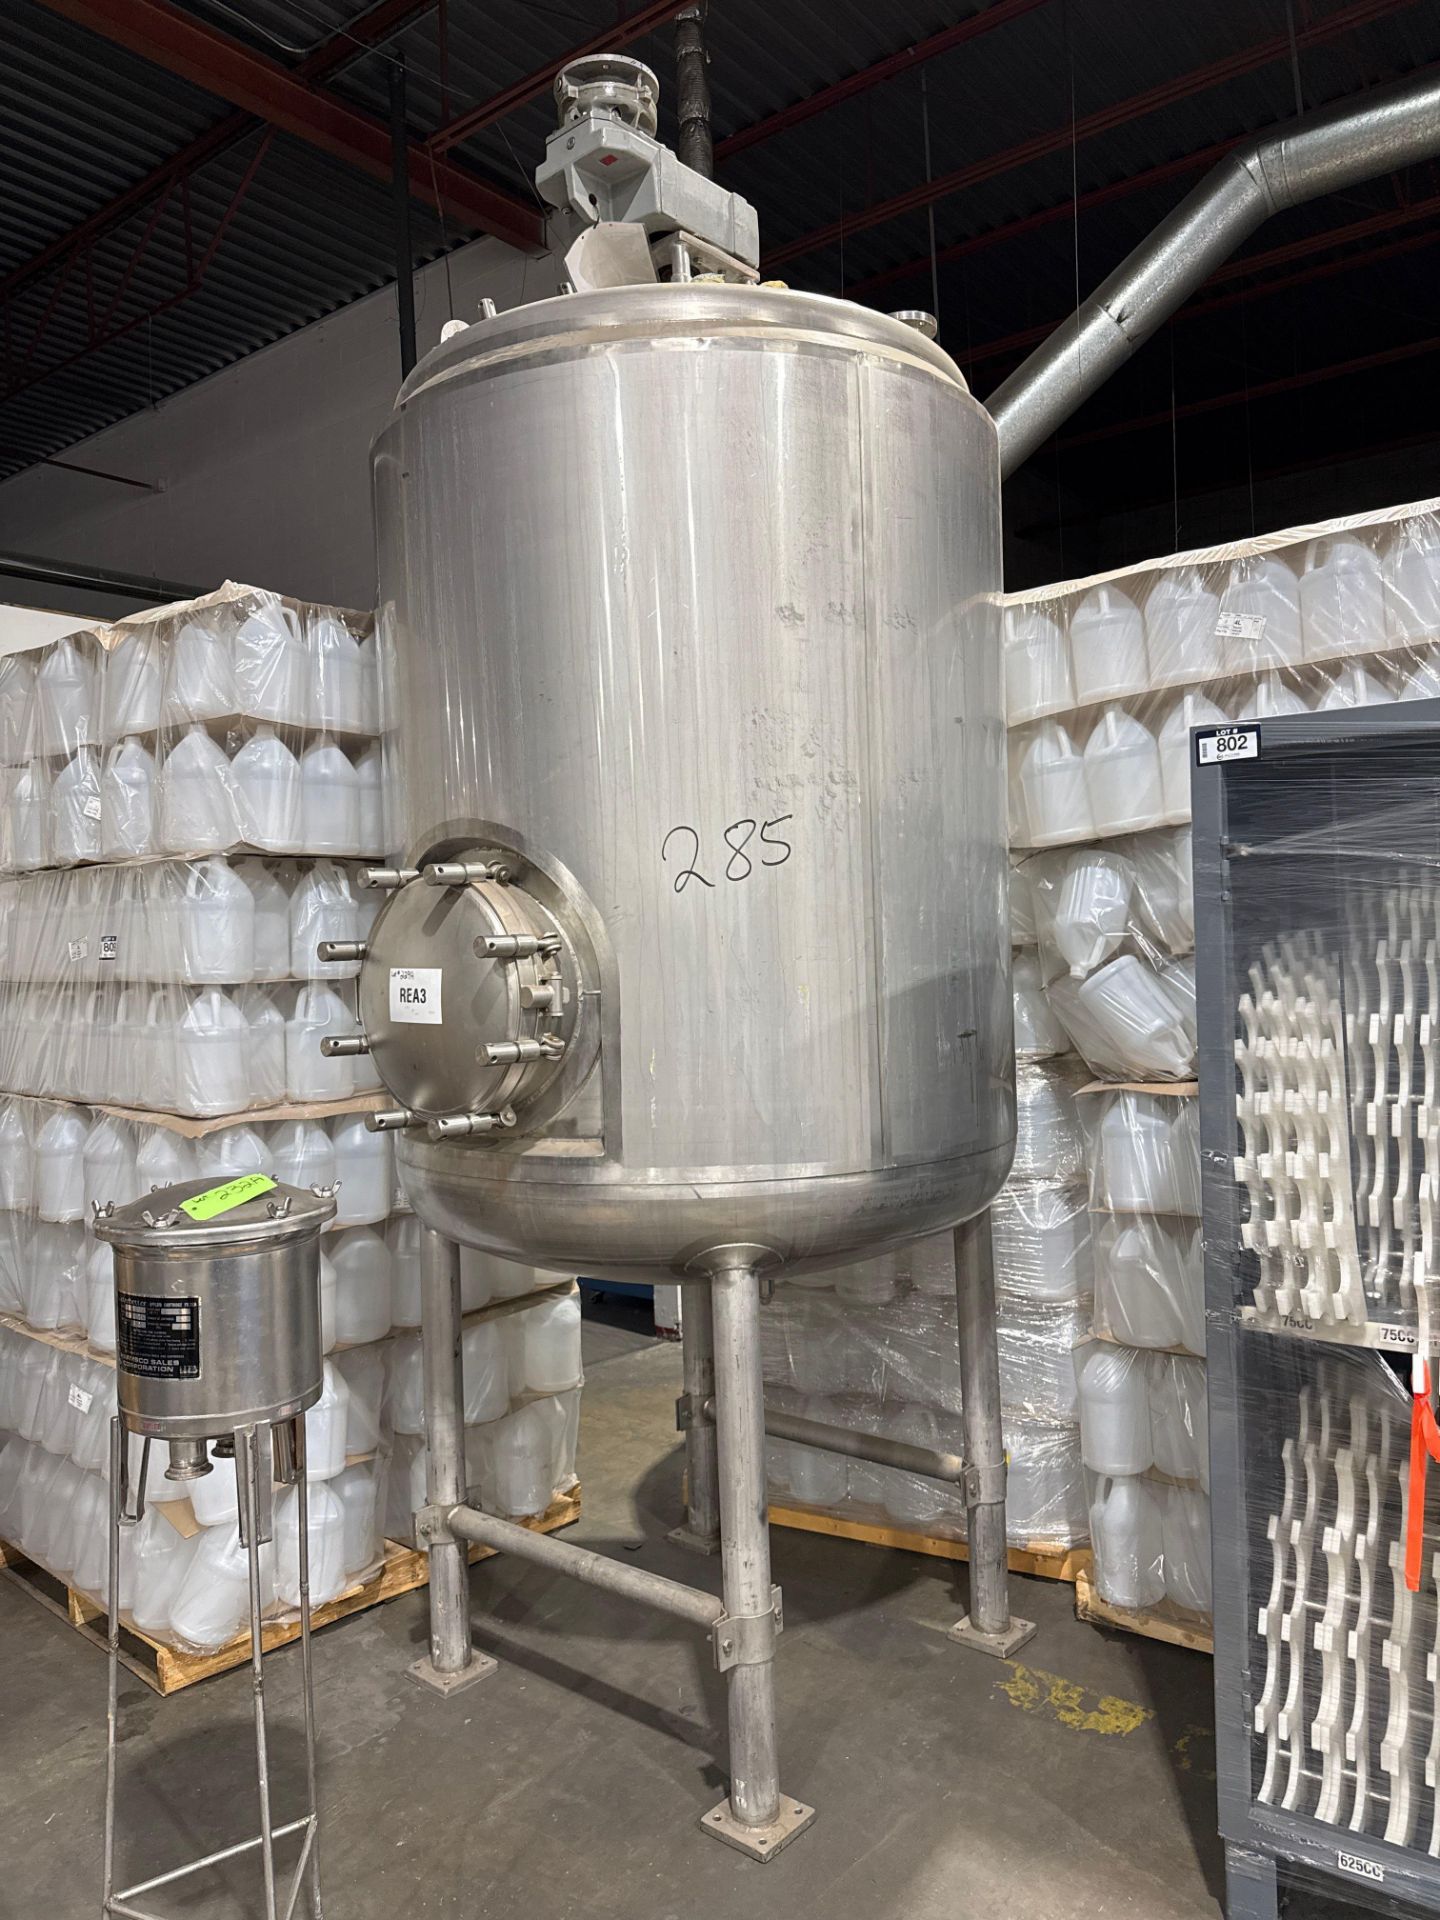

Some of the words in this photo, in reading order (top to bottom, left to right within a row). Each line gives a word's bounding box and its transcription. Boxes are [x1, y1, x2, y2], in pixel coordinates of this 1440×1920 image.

[1215, 728, 1232, 737] LOT
[1216, 735, 1248, 753] 802
[662, 814, 793, 893] 285
[399, 987, 427, 1004] REA3
[1380, 1327, 1416, 1344] 75CC
[123, 1361, 174, 1373] CORPORATION
[150, 1359, 180, 1367] SALES
[1340, 1854, 1381, 1878] 625CC
